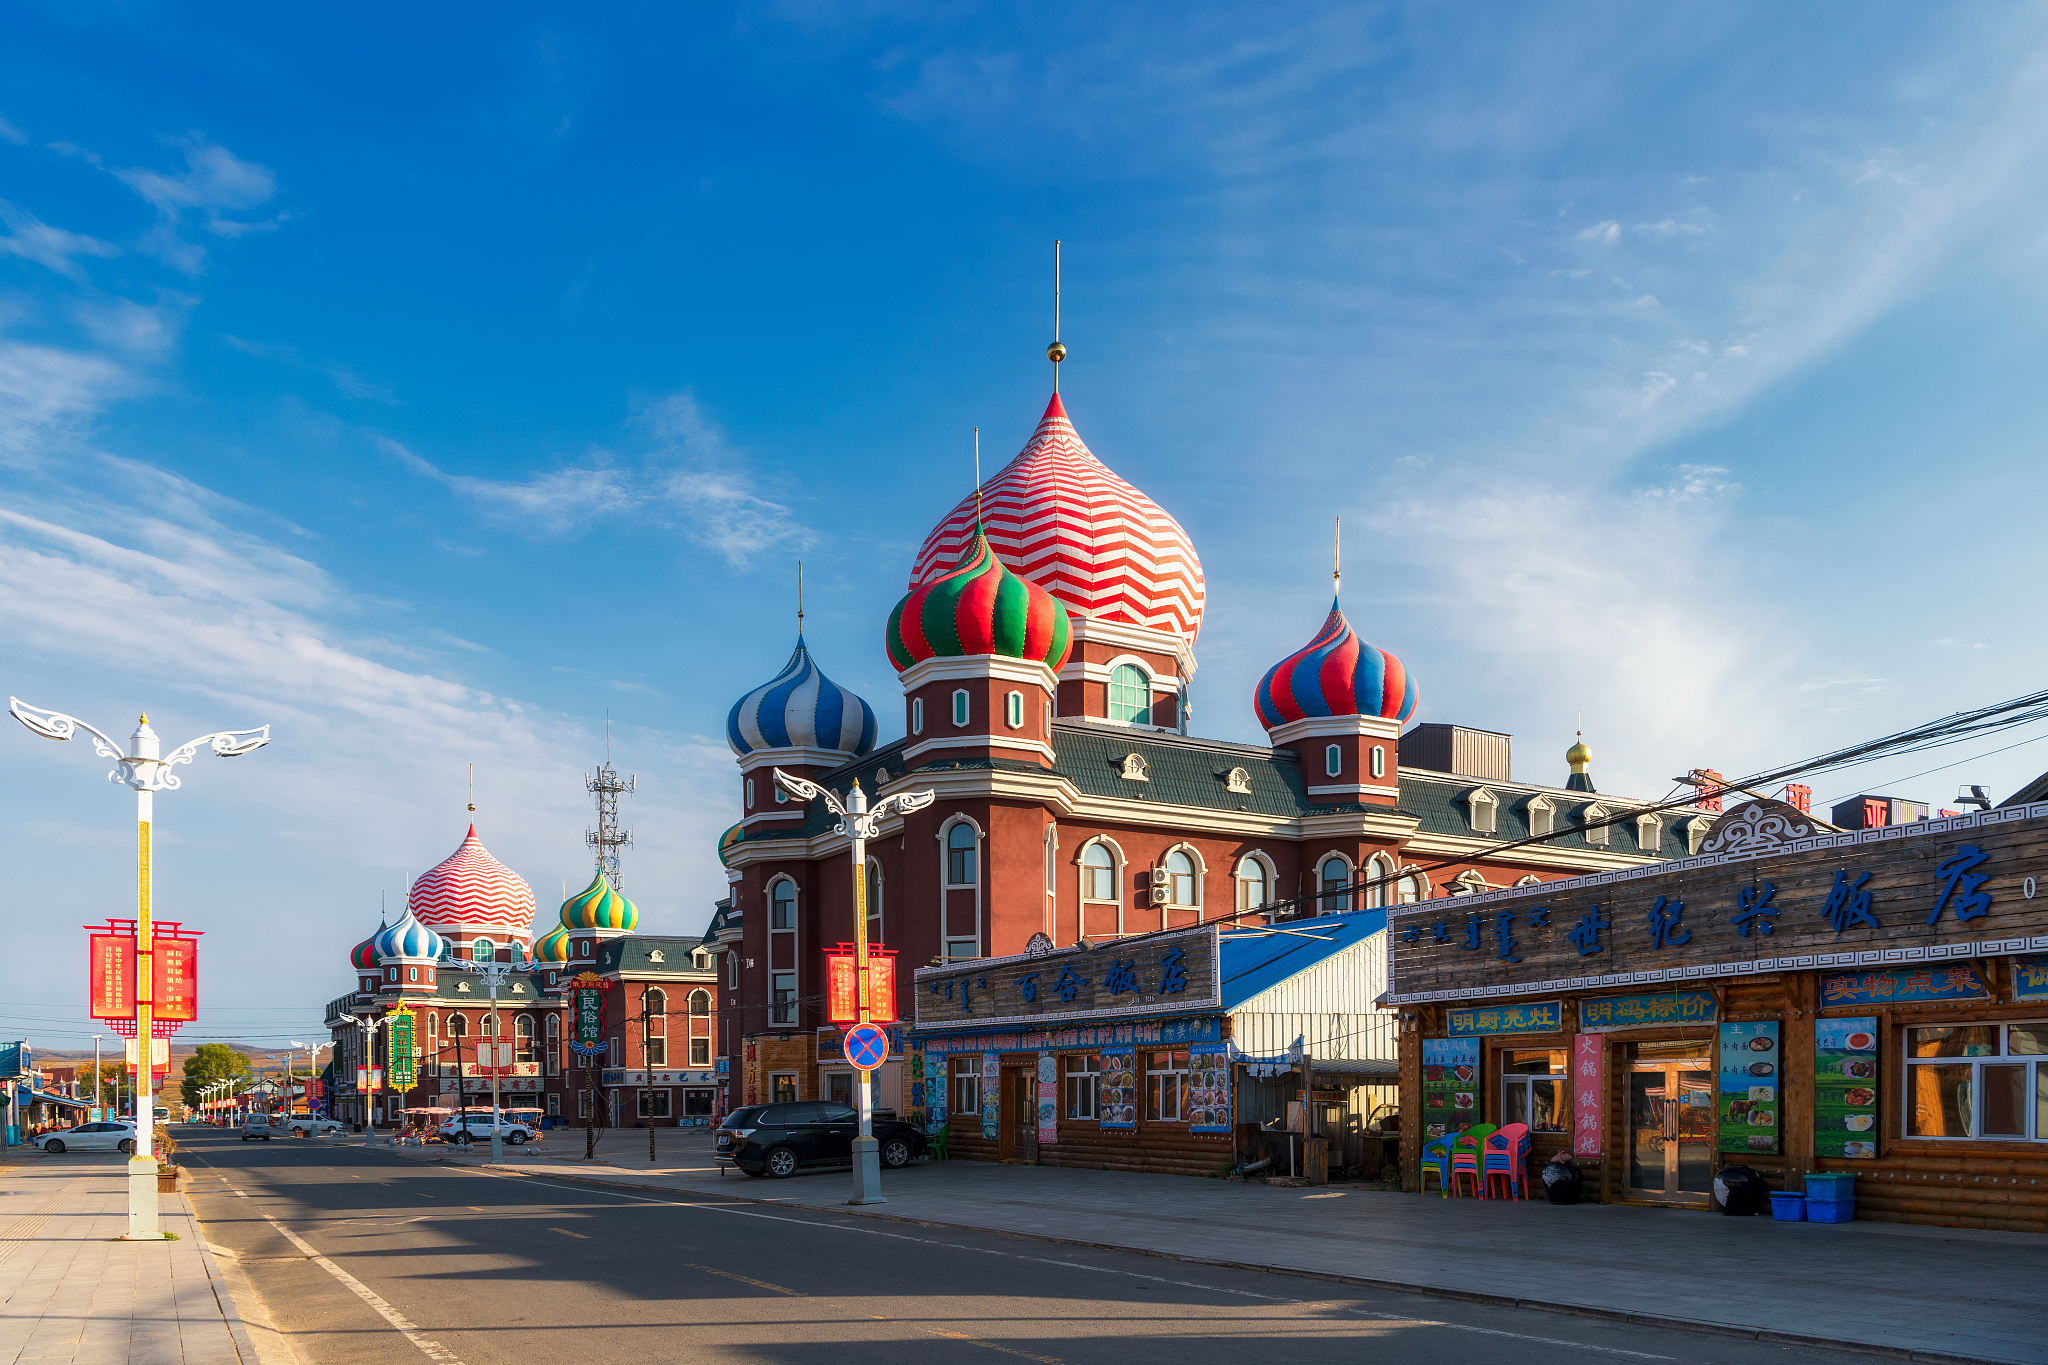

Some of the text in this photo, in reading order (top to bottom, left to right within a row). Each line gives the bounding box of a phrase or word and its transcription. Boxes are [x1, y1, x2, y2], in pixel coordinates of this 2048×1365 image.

[1567, 845, 1992, 956] 世纪兴饭店
[2023, 876, 2037, 899] 0
[166, 950, 174, 1011] 同心共筑中国梦
[175, 950, 183, 1011] 民族团结一家亲
[572, 980, 610, 989] 俄罗斯风情
[1013, 947, 1188, 1003] 百合饭店
[1824, 966, 1982, 1000] 实物点菜
[581, 997, 599, 1038] 民俗馆
[1452, 1006, 1556, 1032] 明厨亮灶
[1586, 994, 1712, 1022] 明码标价
[1730, 1023, 1767, 1035] 主食
[1819, 1020, 1873, 1032] 俄罗斯风味
[1432, 1039, 1469, 1051] 蒙古风味
[1721, 1041, 1749, 1052] 牛肉面
[1721, 1065, 1749, 1076] 羊肉面
[1579, 1036, 1599, 1154] 火锅 铁锅炖
